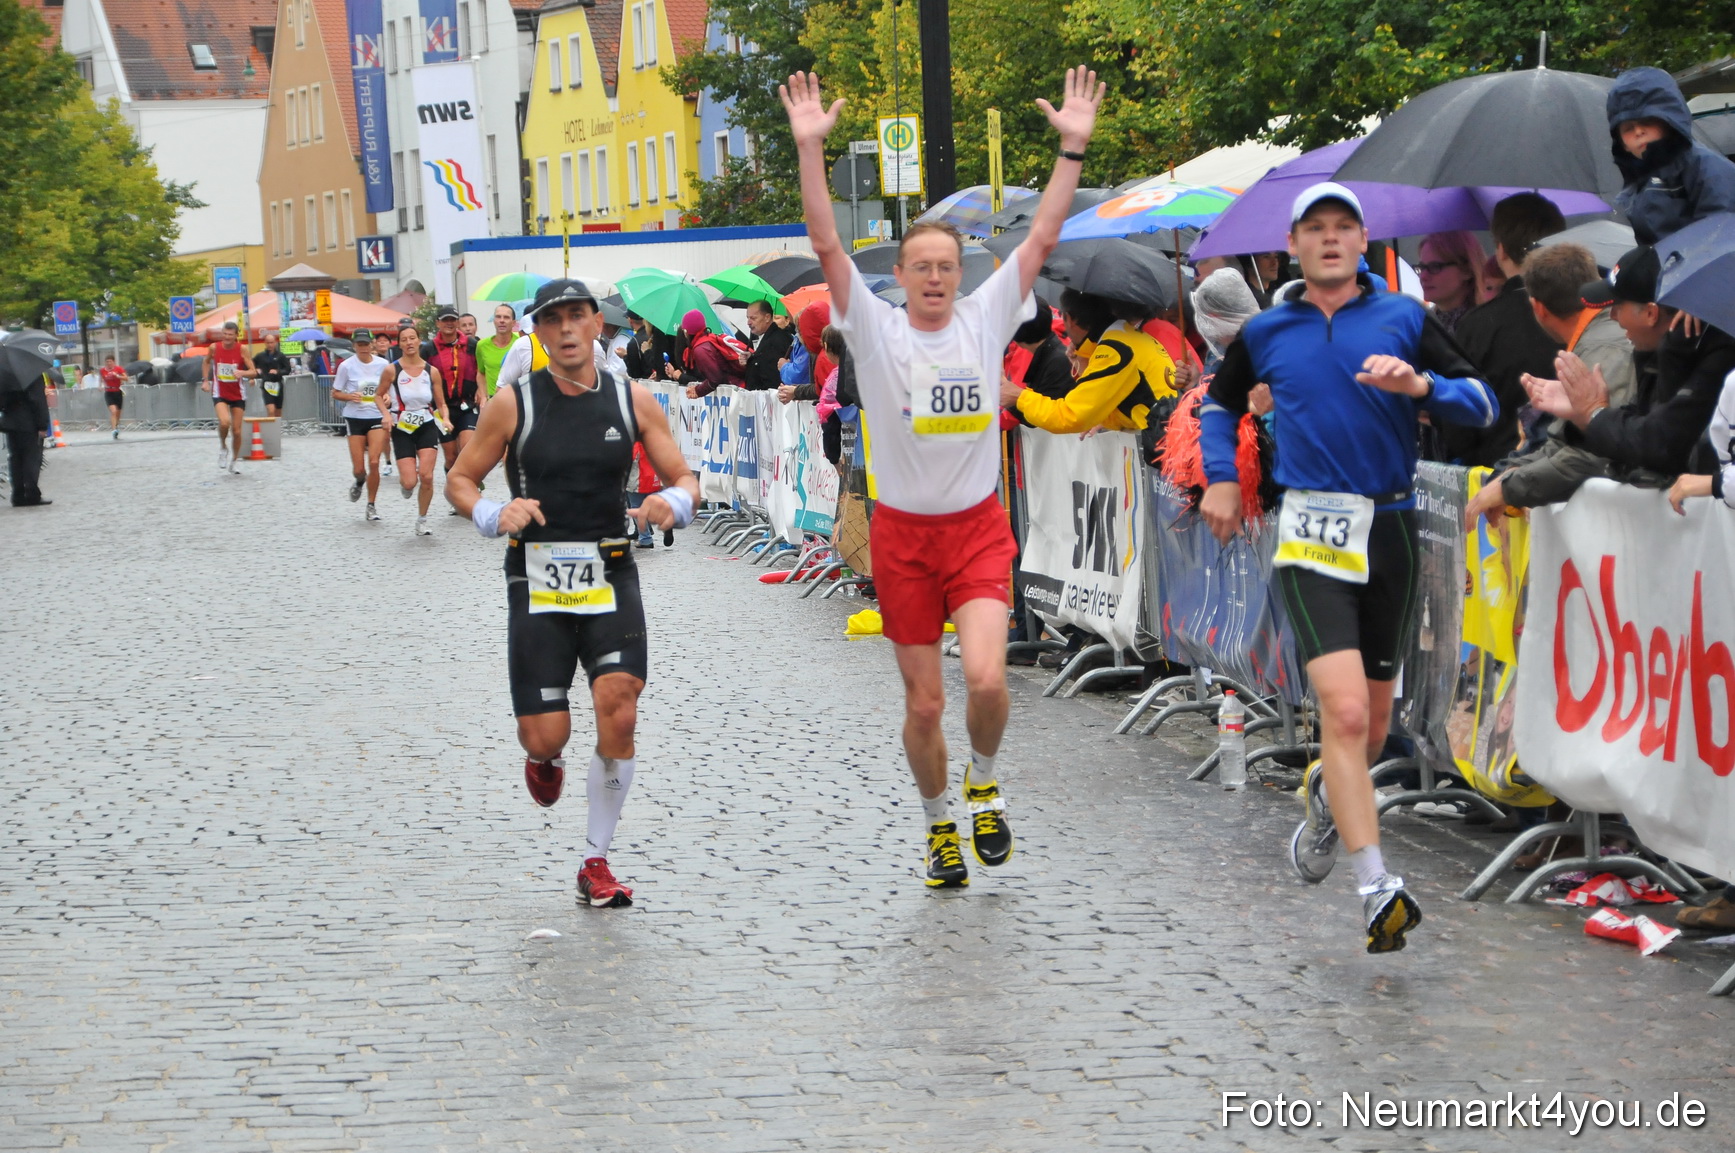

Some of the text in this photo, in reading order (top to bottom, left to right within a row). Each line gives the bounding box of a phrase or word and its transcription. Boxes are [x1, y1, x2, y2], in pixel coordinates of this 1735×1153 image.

[563, 119, 586, 144] HOTEL
[858, 143, 875, 151] Ulmer
[172, 321, 192, 330] TAXI
[931, 384, 981, 413] 805
[405, 412, 425, 426] 328
[928, 418, 976, 433] Stefan
[1295, 512, 1352, 547] 313
[1304, 546, 1338, 564] Frank
[545, 563, 595, 590] 374
